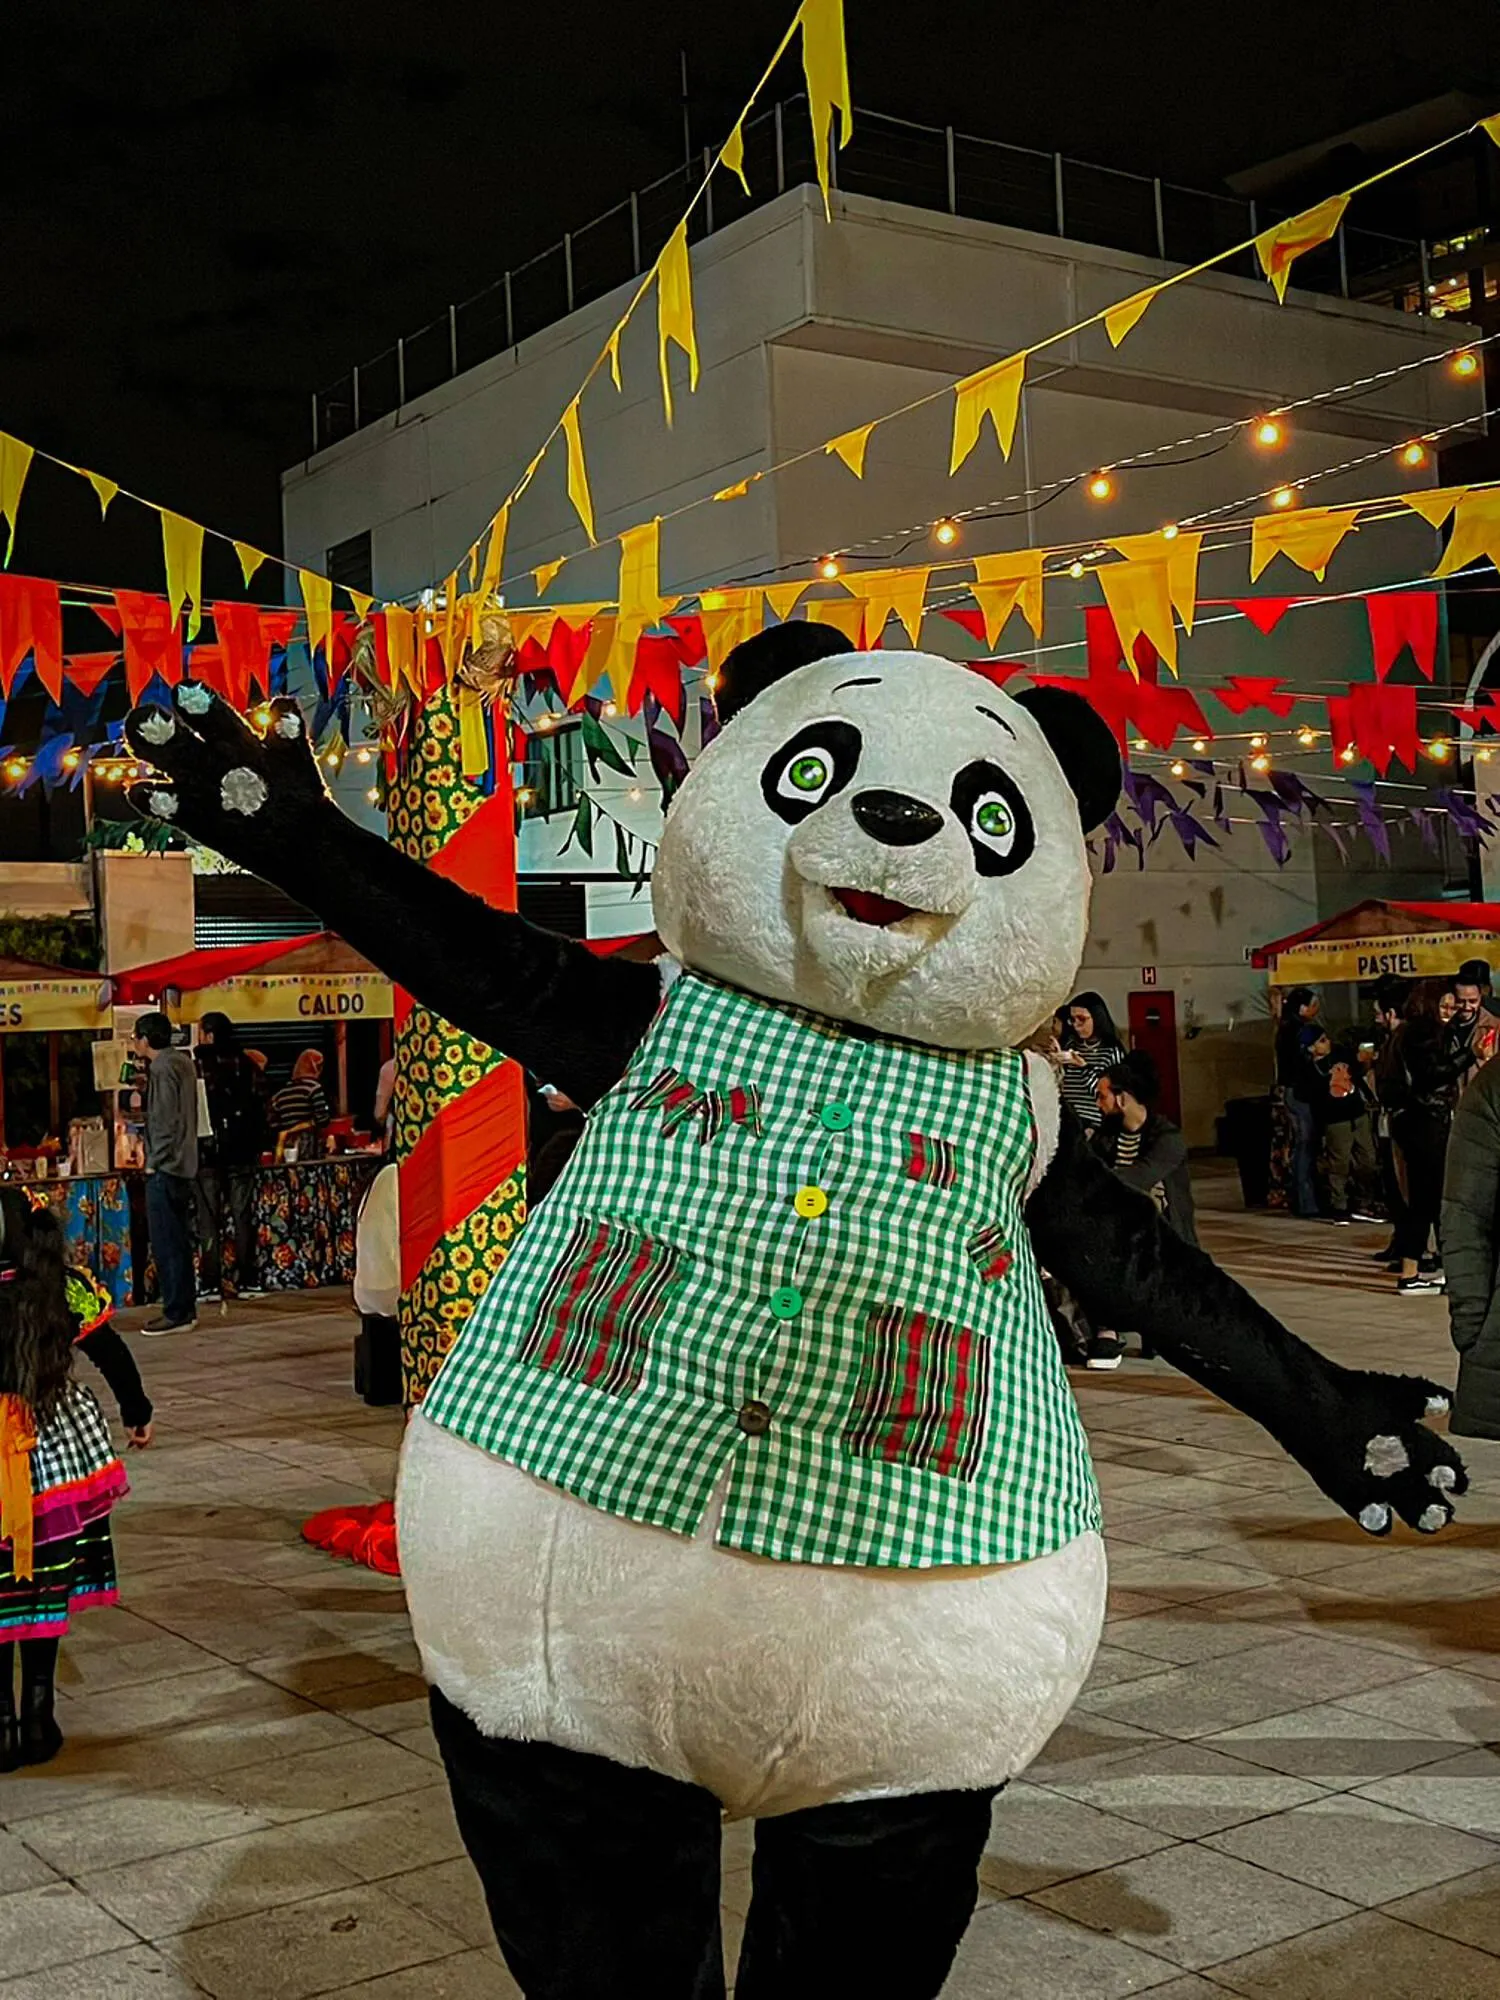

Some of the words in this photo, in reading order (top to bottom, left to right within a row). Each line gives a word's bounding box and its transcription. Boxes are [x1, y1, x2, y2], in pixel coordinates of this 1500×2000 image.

[1144, 967, 1155, 984] H
[1358, 953, 1417, 976] PASTEL
[298, 992, 364, 1015] CALDO
